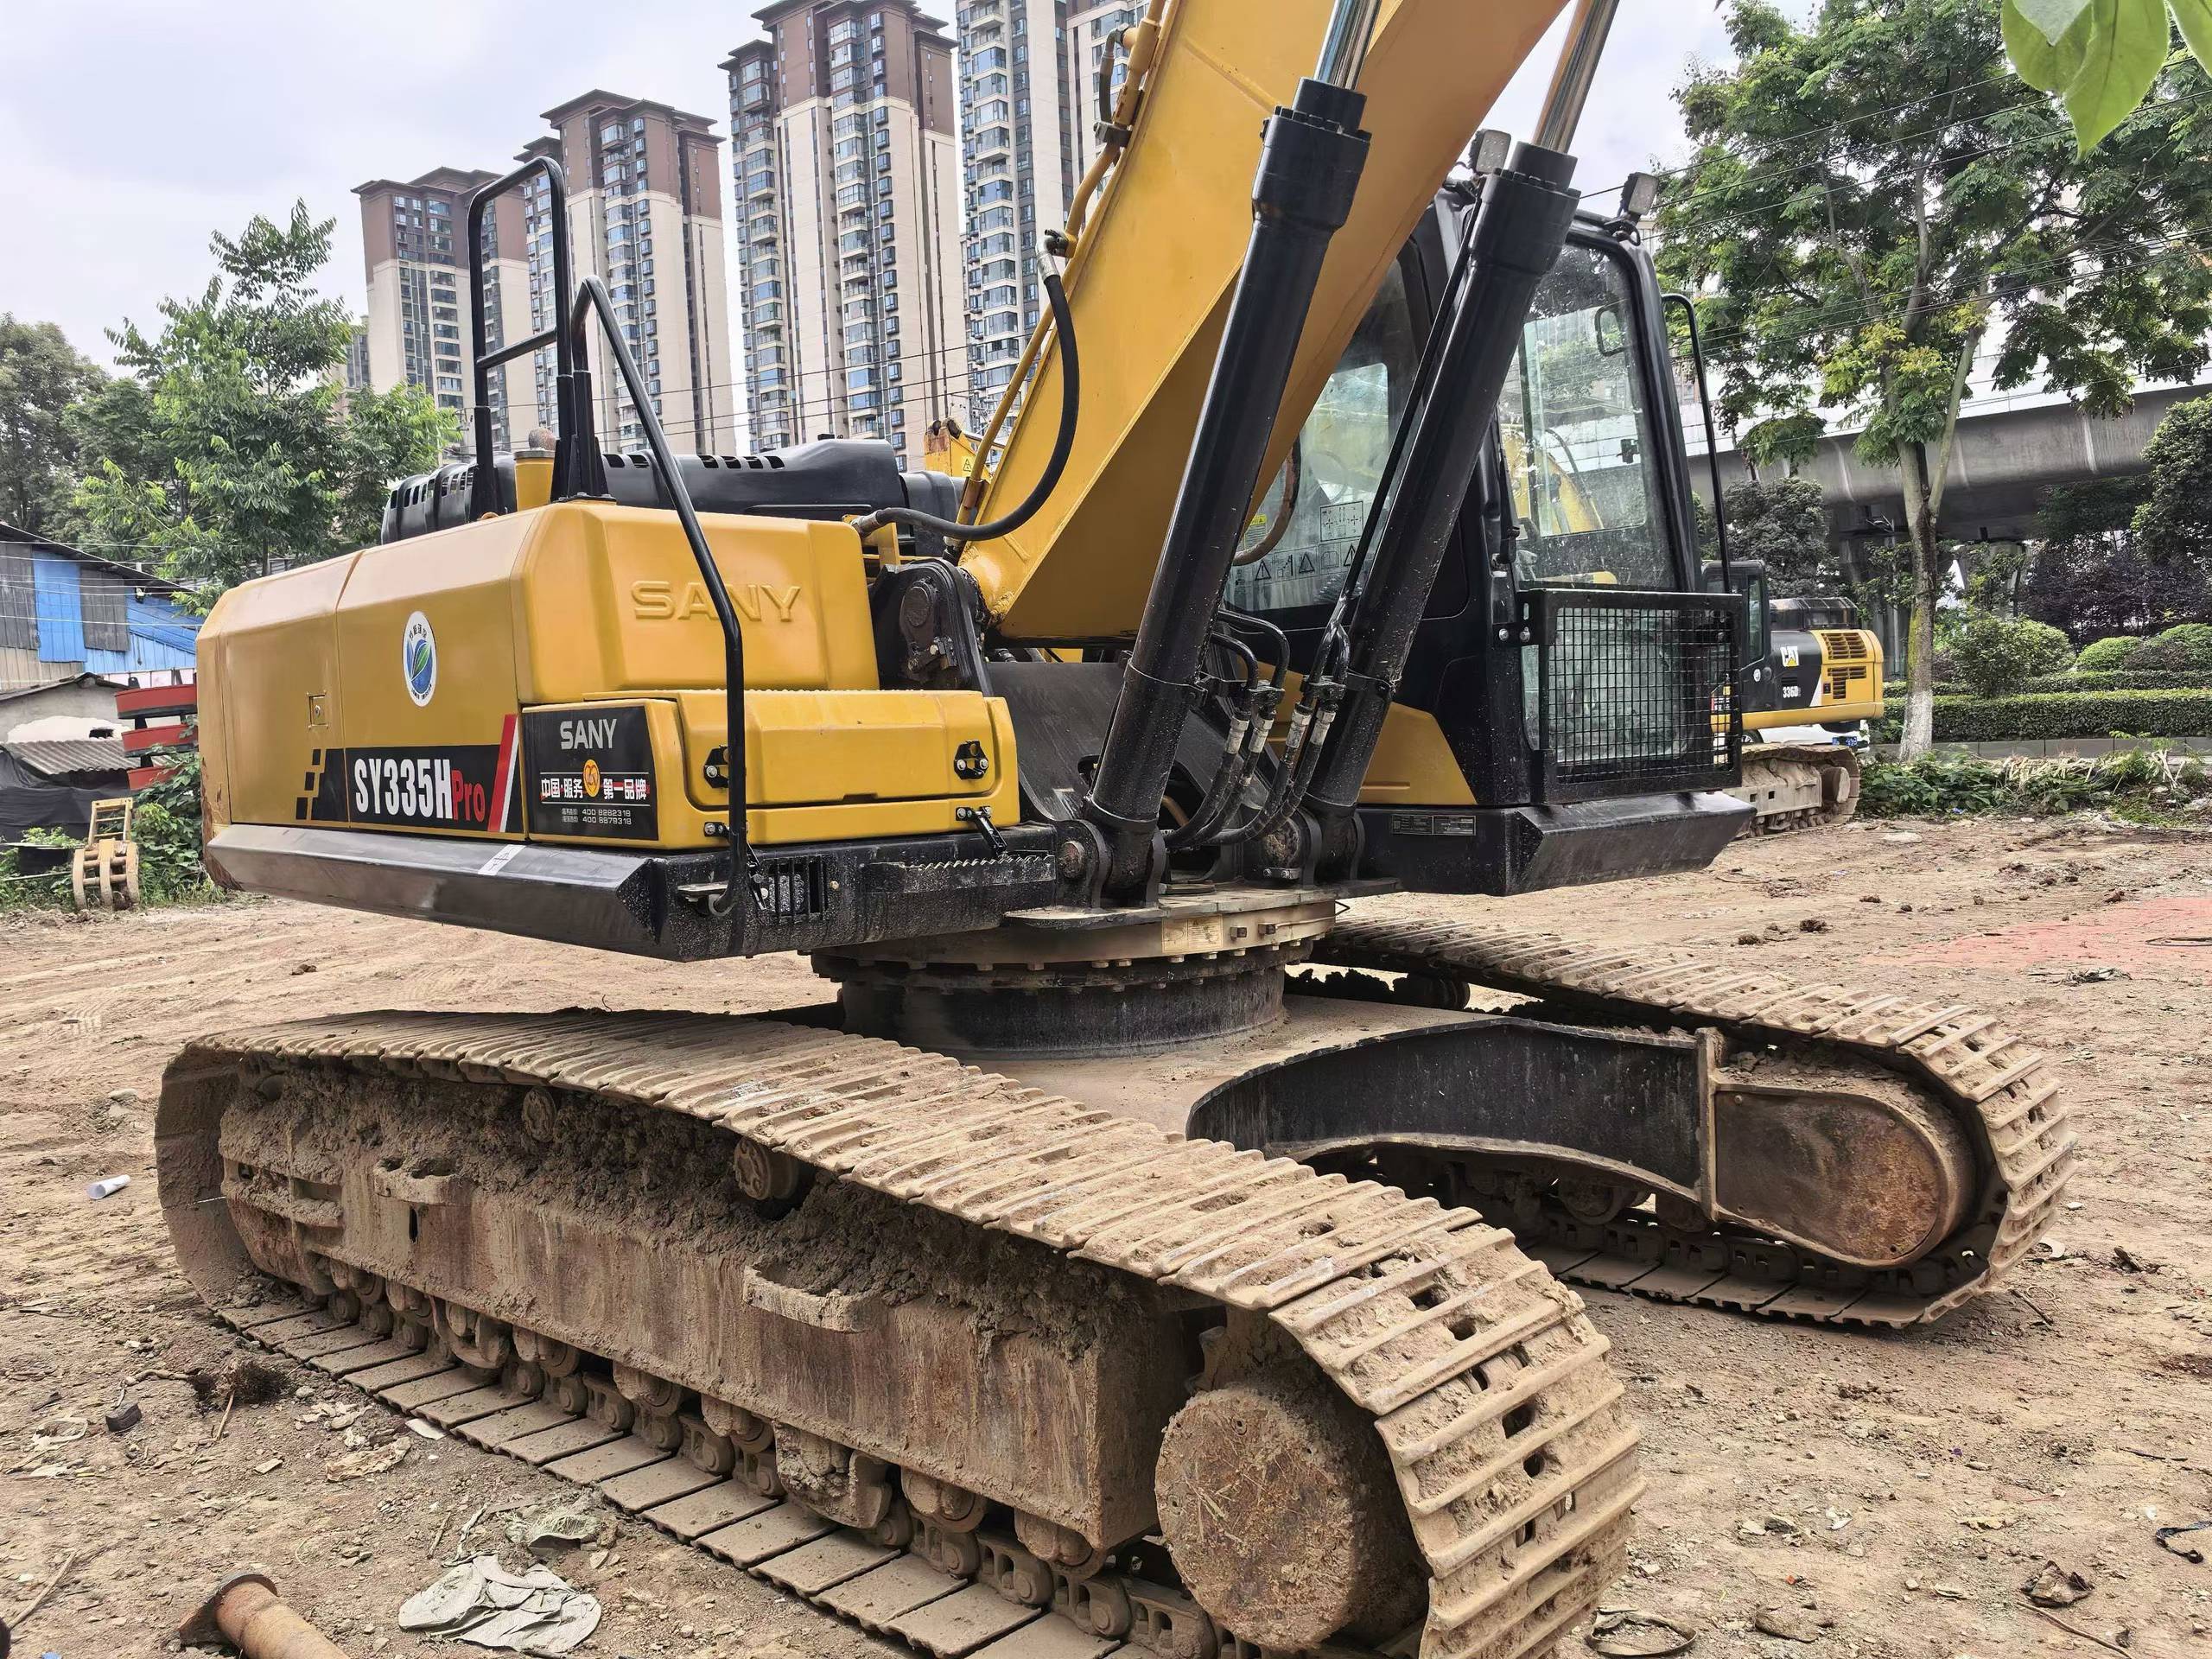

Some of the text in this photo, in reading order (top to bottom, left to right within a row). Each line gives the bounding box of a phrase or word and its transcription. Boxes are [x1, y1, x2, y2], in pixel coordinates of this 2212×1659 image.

[632, 581, 800, 623] SANY
[1780, 645, 1799, 667] CAT
[560, 719, 617, 750] SANY
[603, 779, 647, 800] 第一品牌
